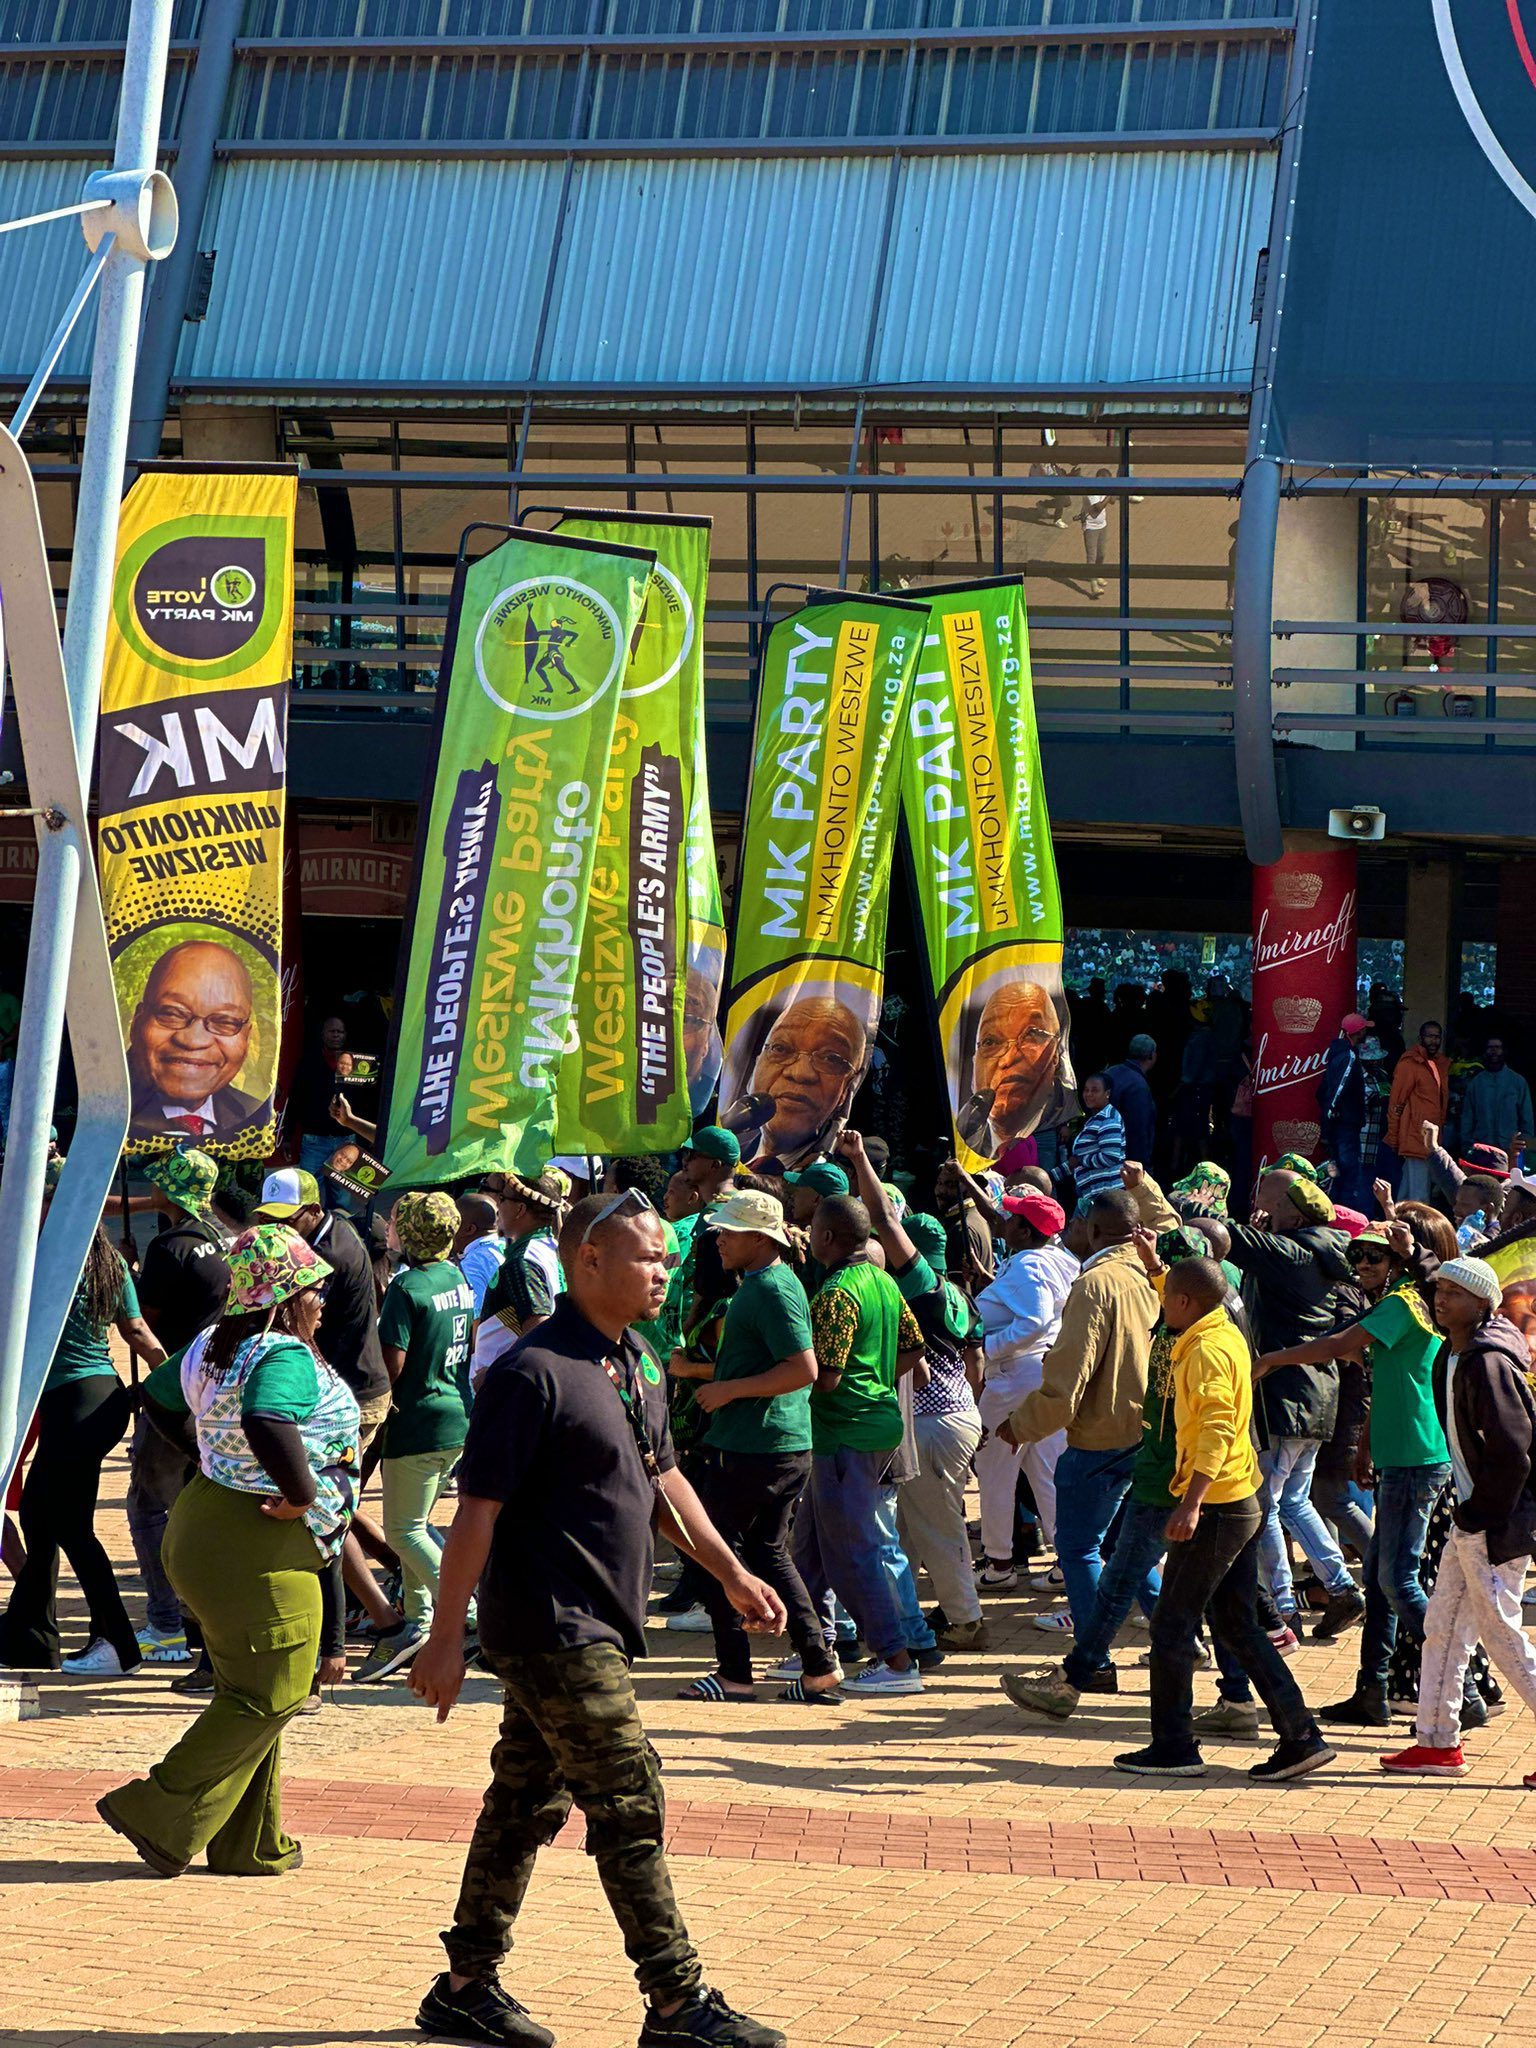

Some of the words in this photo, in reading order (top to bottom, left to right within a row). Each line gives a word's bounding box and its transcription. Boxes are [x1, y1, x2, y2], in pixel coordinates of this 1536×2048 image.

[651, 574, 680, 614] SIZWE
[771, 622, 833, 821] PARTY
[909, 633, 966, 823] PAR
[953, 615, 986, 747] WESIZWE
[816, 764, 852, 937] uMKHONTO
[836, 626, 871, 755] WESIZWE
[852, 634, 906, 942] www.mkparty.org.za
[971, 754, 1009, 926] uMKHONTO
[995, 614, 1046, 923] www.mkparty.org.za
[301, 856, 402, 888] MIRNOFF
[760, 838, 811, 939] MK
[932, 837, 980, 939] MK
[1252, 889, 1356, 973] Smirnoff
[581, 866, 626, 1104] Wesizwe
[432, 1290, 458, 1312] VOTE
